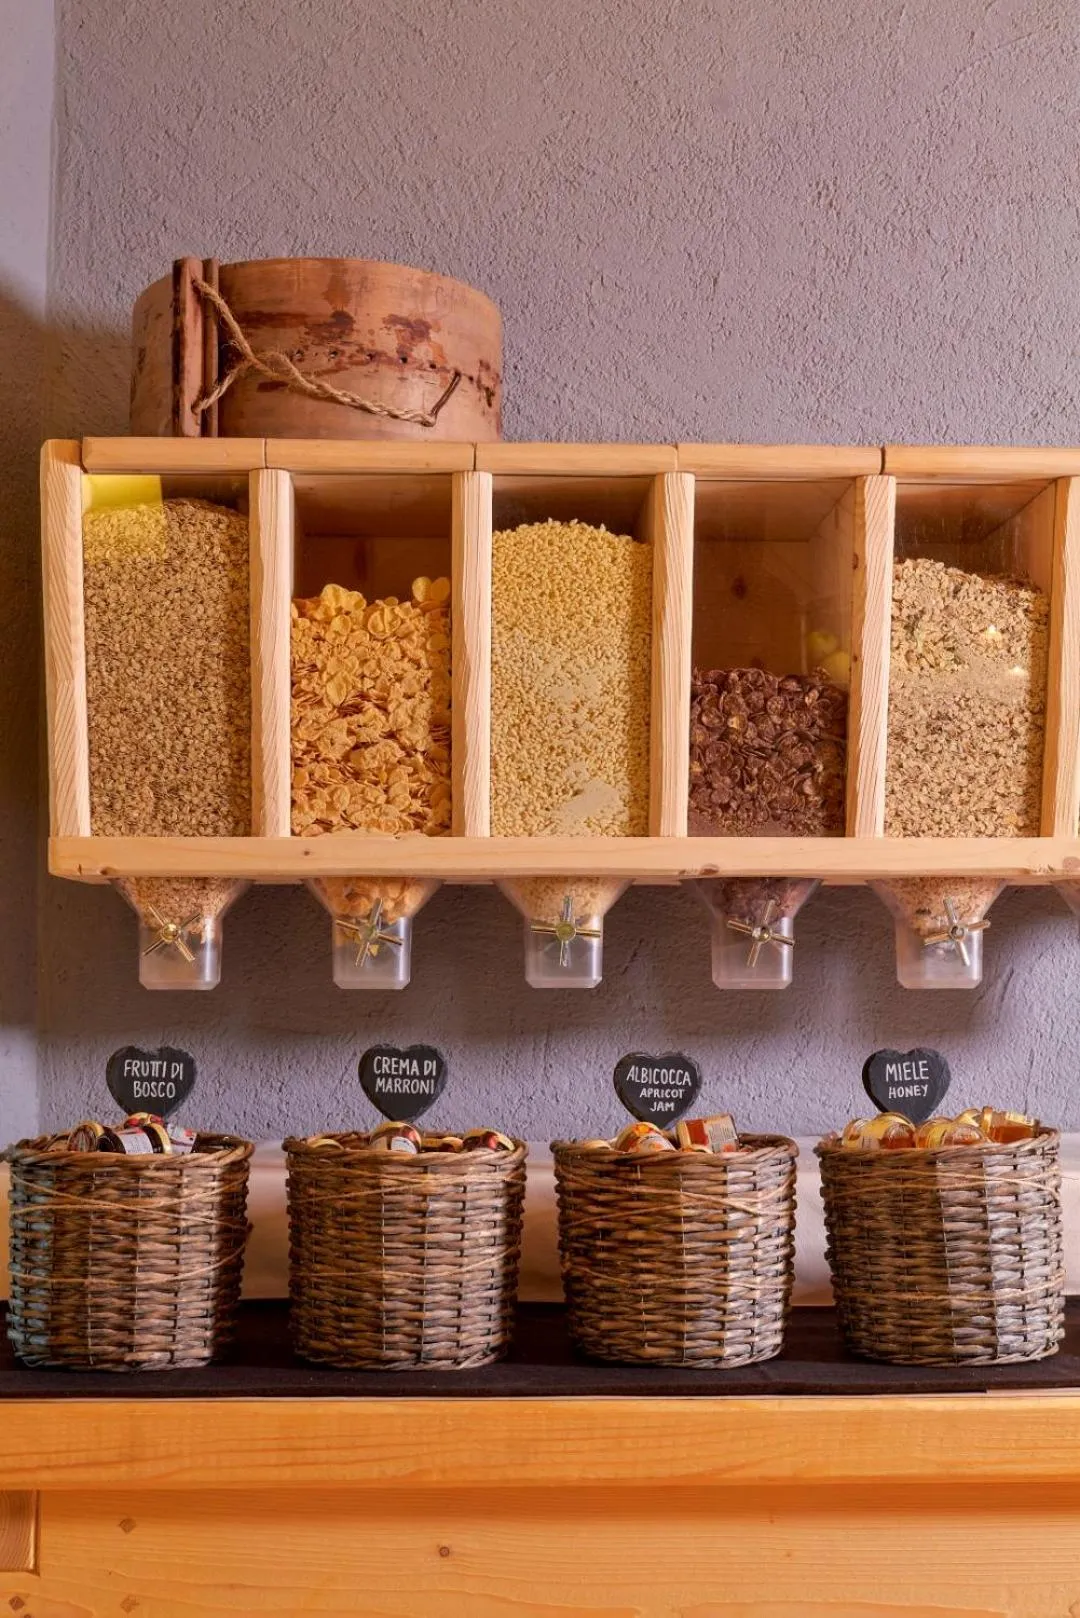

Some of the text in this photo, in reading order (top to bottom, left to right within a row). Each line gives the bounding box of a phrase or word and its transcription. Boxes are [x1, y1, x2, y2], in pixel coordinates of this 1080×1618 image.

[123, 1059, 184, 1081] FRUTTI DI
[373, 1056, 437, 1077] CREMA DI
[626, 1065, 692, 1087] ALBICOCCA
[885, 1060, 929, 1082] MIELE
[133, 1080, 176, 1099] BOSCO
[375, 1077, 435, 1095] MARRONI
[639, 1087, 686, 1099] APRICOT
[888, 1084, 929, 1099] HONEY
[649, 1101, 675, 1112] JAM
